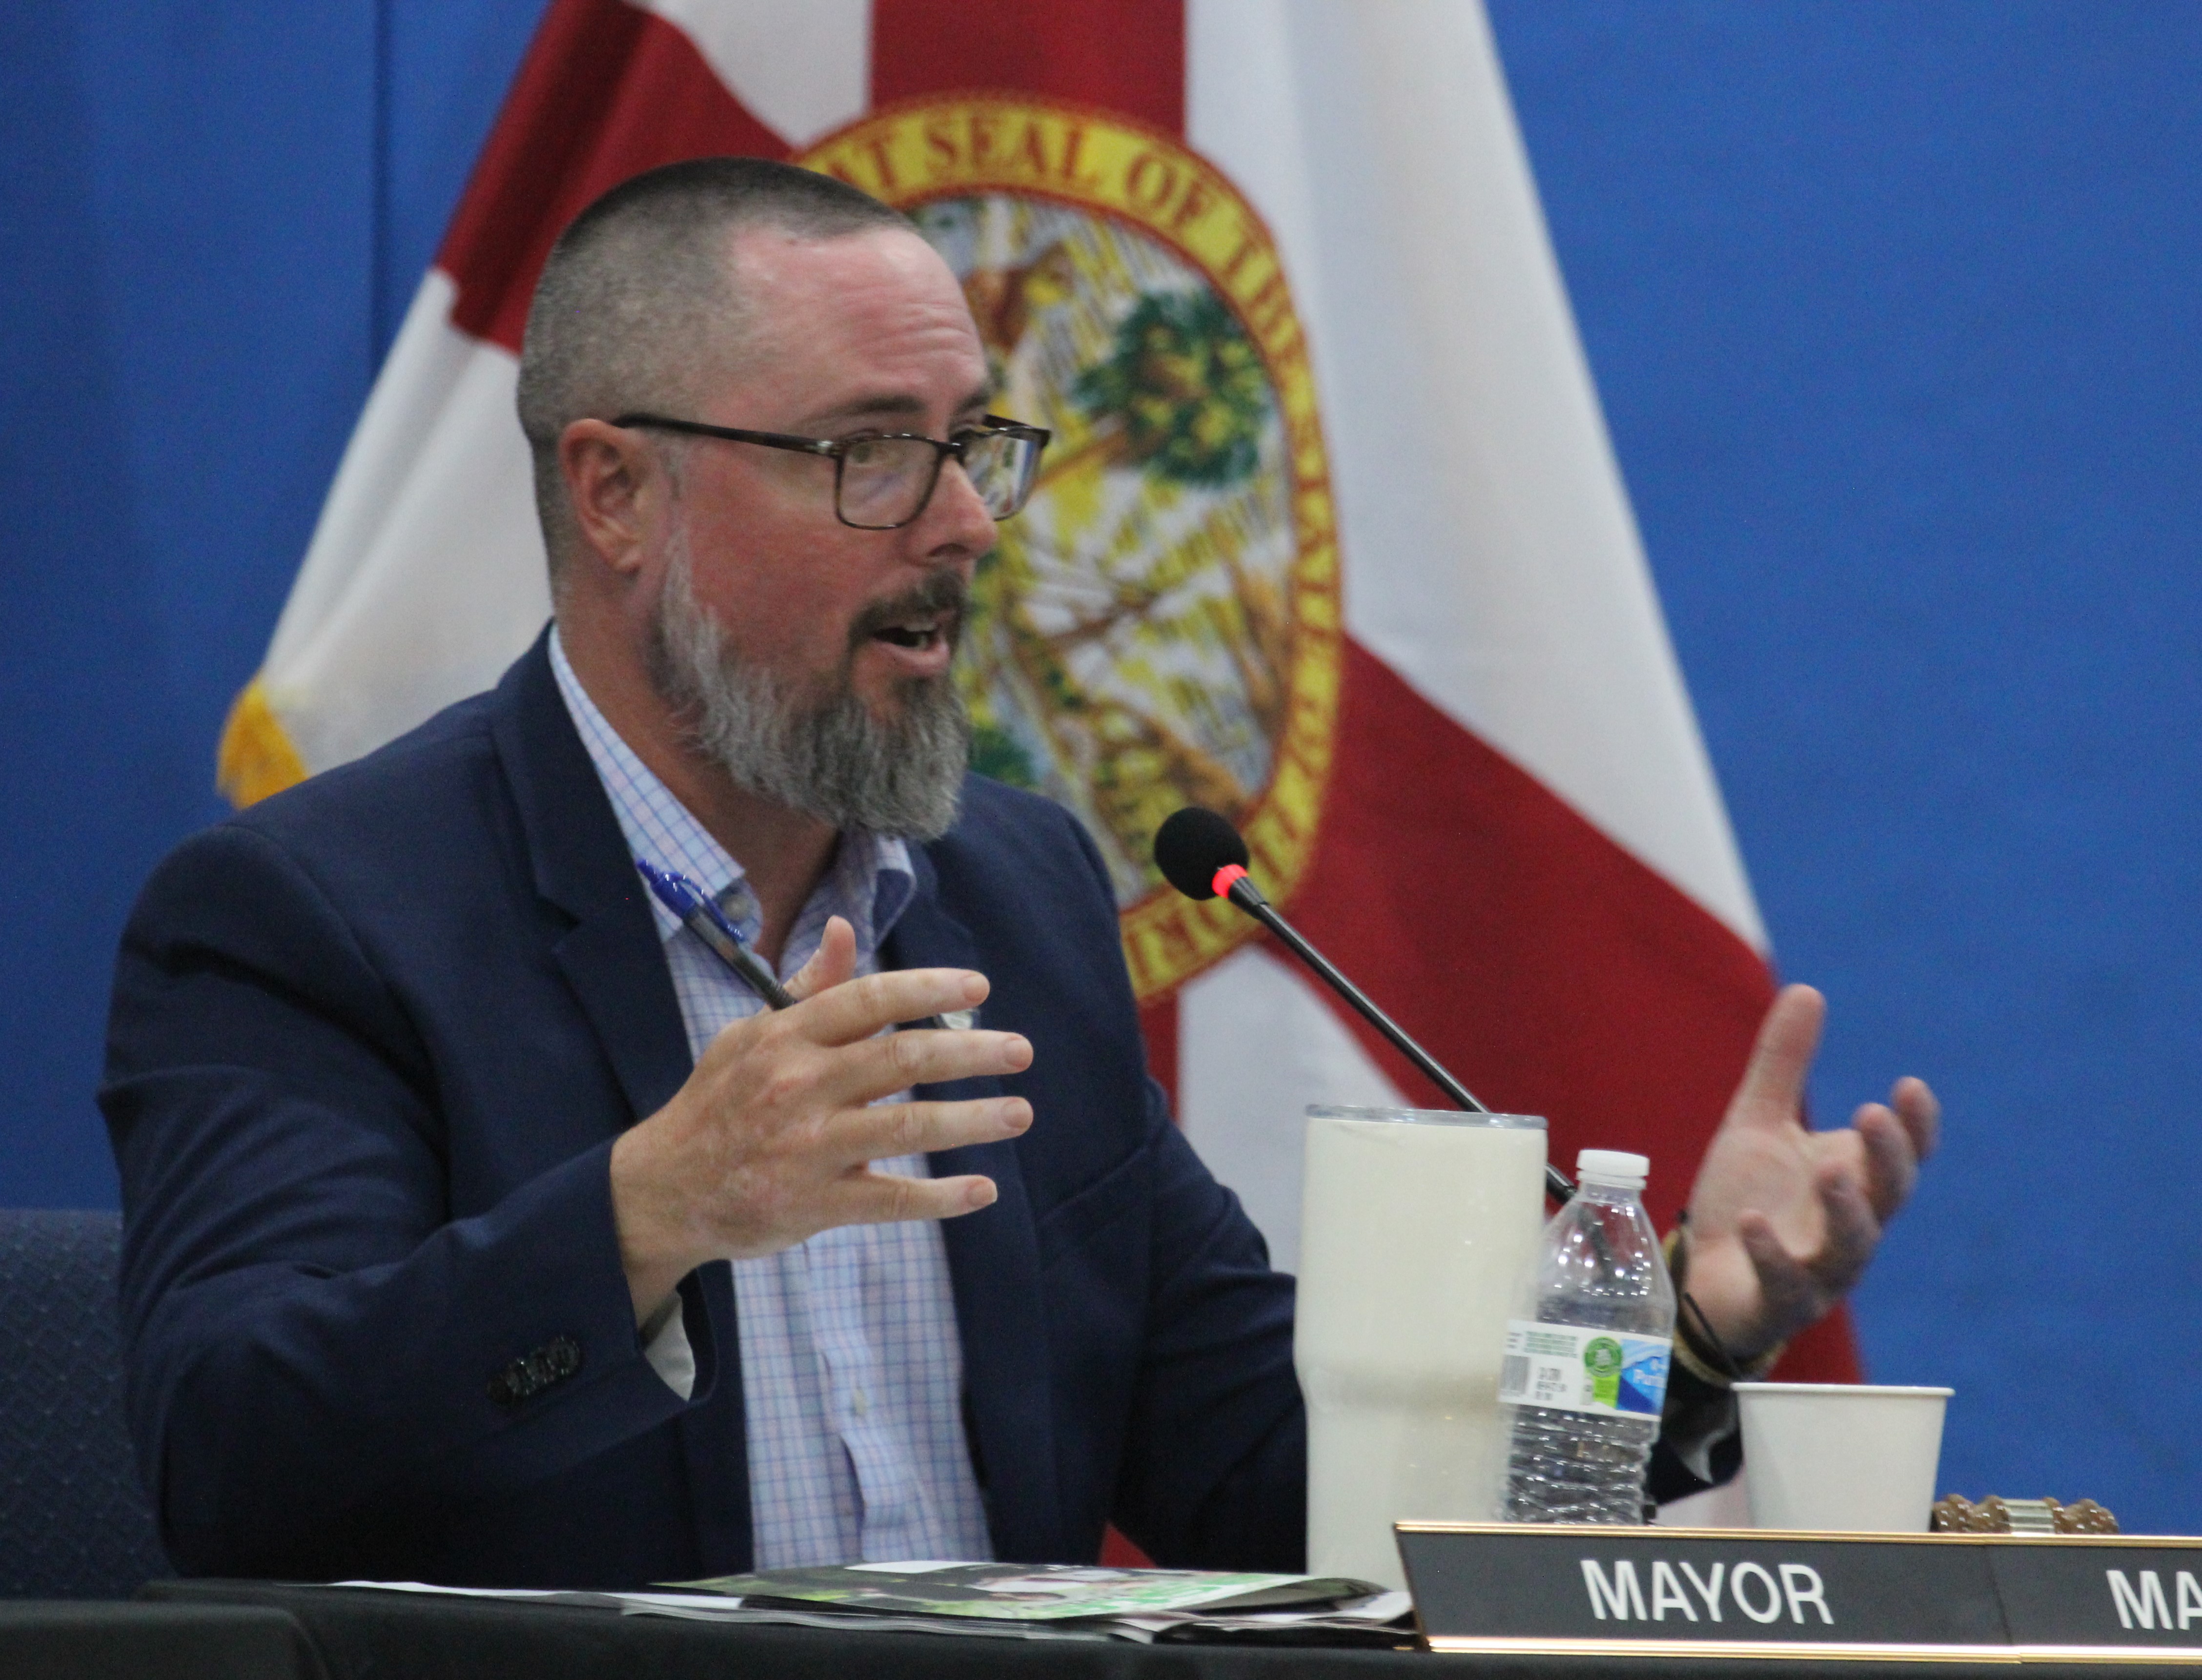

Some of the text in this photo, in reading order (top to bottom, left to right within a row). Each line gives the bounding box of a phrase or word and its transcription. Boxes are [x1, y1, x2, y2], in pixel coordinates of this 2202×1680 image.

[925, 111, 1100, 182] SEAL
[1123, 149, 1214, 225] OF
[1580, 1560, 1835, 1625] MAYOR
[2105, 1569, 2202, 1631] MA
